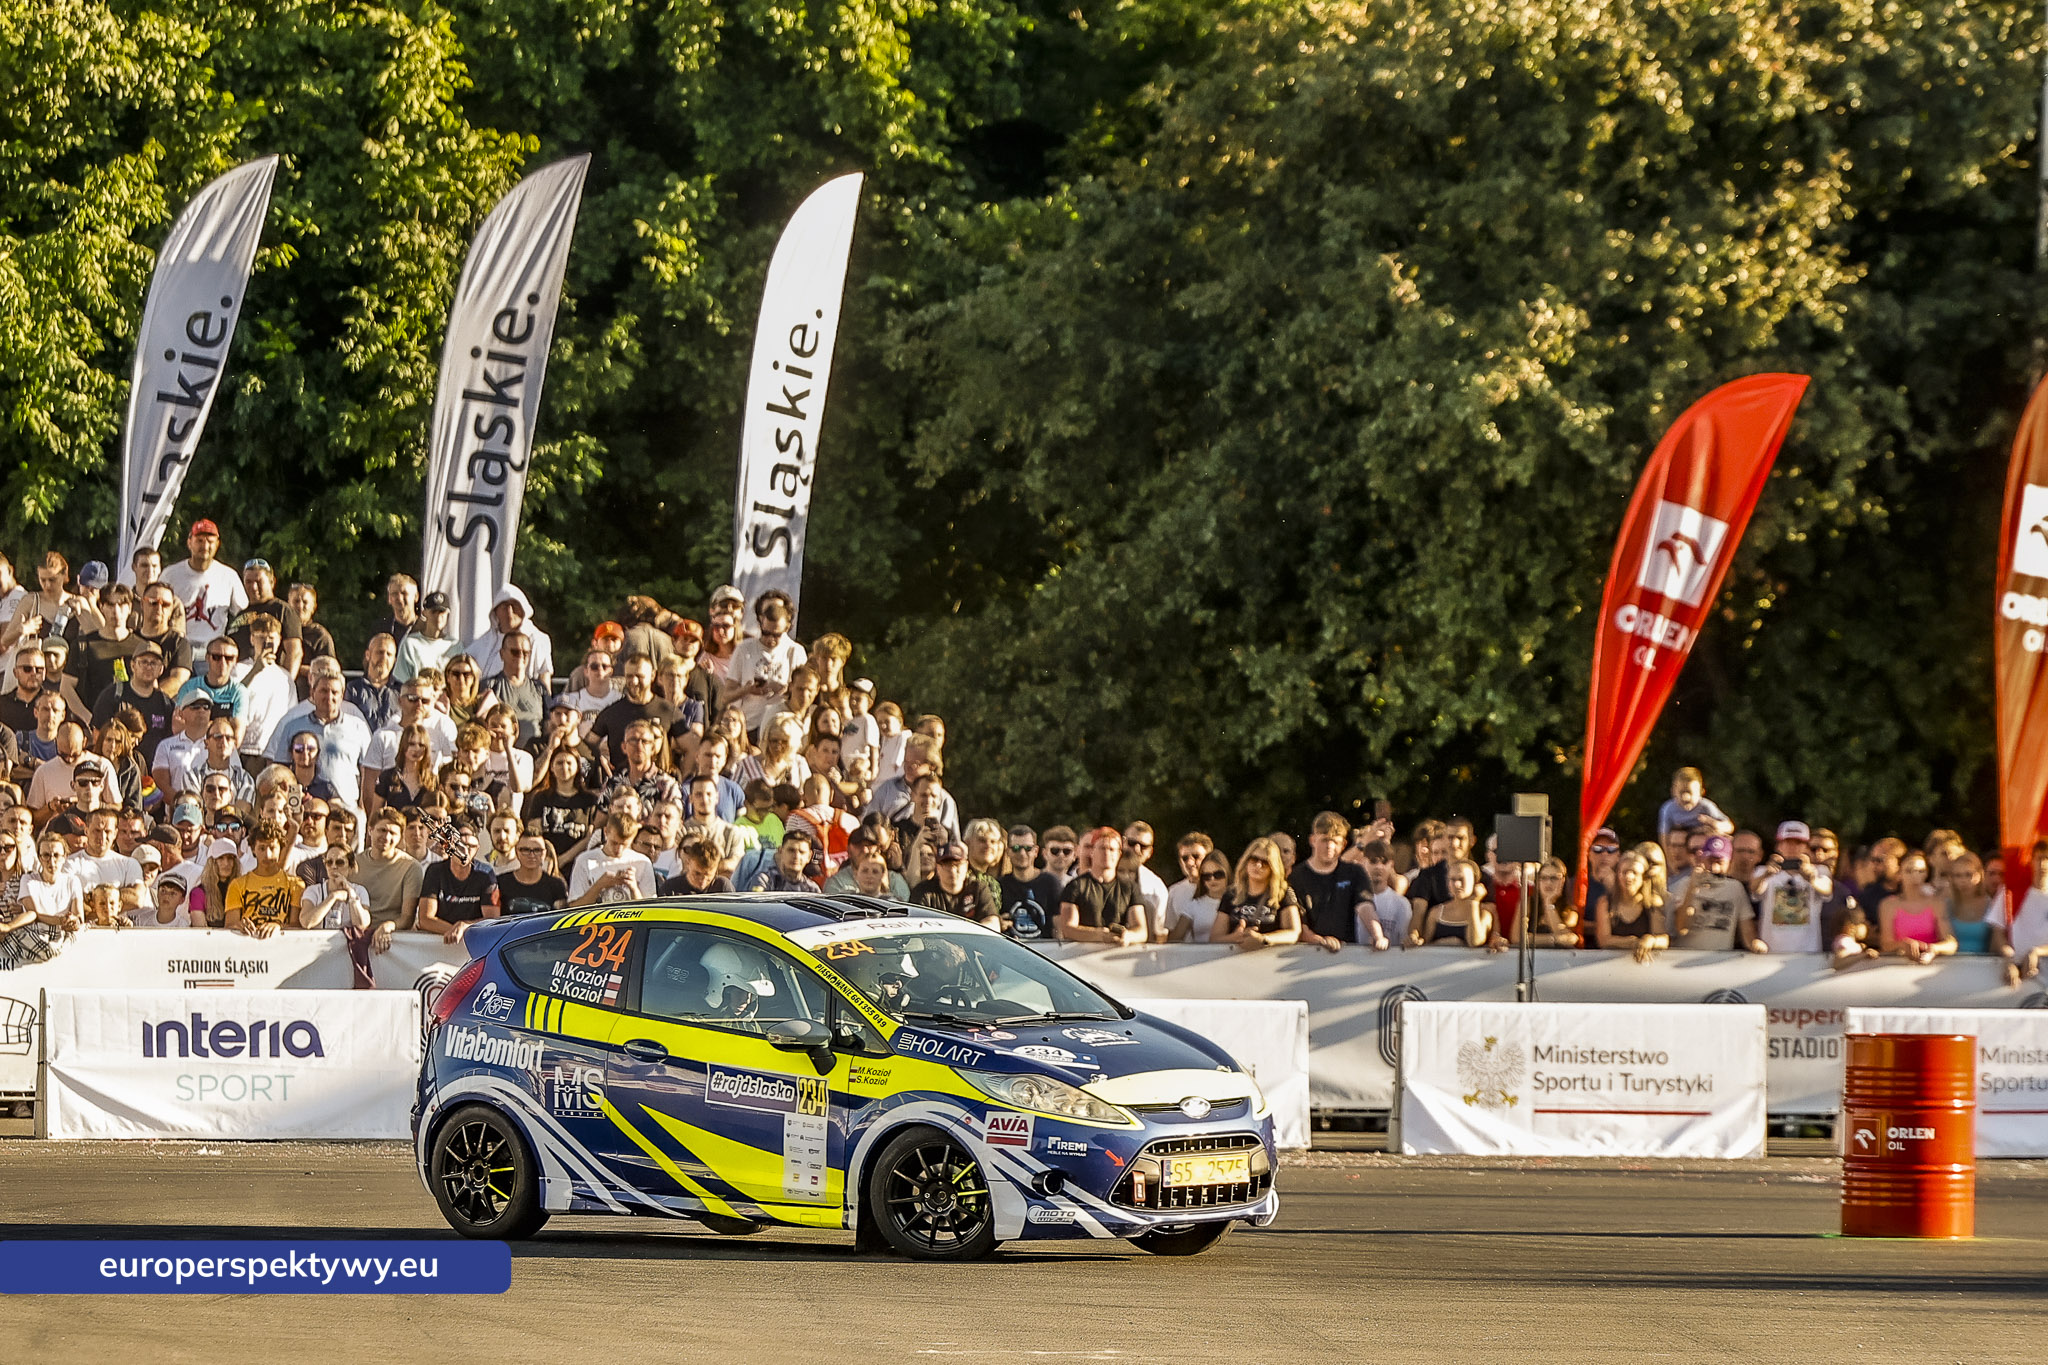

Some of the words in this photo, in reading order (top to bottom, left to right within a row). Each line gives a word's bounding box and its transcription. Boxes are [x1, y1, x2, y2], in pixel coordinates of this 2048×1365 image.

[437, 291, 540, 553] Śląskie.
[746, 308, 824, 566] Śląskie.
[605, 909, 643, 919] FIREMI
[568, 923, 633, 972] 234
[813, 939, 876, 960] 234
[168, 960, 221, 974] STADION
[225, 956, 268, 978] ŚLĄSKI
[551, 961, 607, 987] M.Kozioł
[815, 963, 853, 997] PIASKOWANIE
[550, 978, 604, 1004] S.Kozioł
[142, 1012, 325, 1058] interia
[444, 1024, 544, 1072] VitaComfort
[1533, 1045, 1669, 1066] Ministerstwo
[856, 1075, 888, 1086] S.Kozioł
[857, 1067, 891, 1077] M.Kozioł
[1533, 1072, 1603, 1093] Sportu
[1608, 1073, 1613, 1091] i
[1620, 1073, 1713, 1096] Turystyki
[176, 1074, 295, 1102] SPORT
[711, 1073, 794, 1101] #rajdslaska
[799, 1079, 827, 1117] 234
[1048, 1136, 1087, 1152] FIREMI
[1887, 1127, 1936, 1140] ORLEN
[1888, 1141, 1906, 1151] OIL
